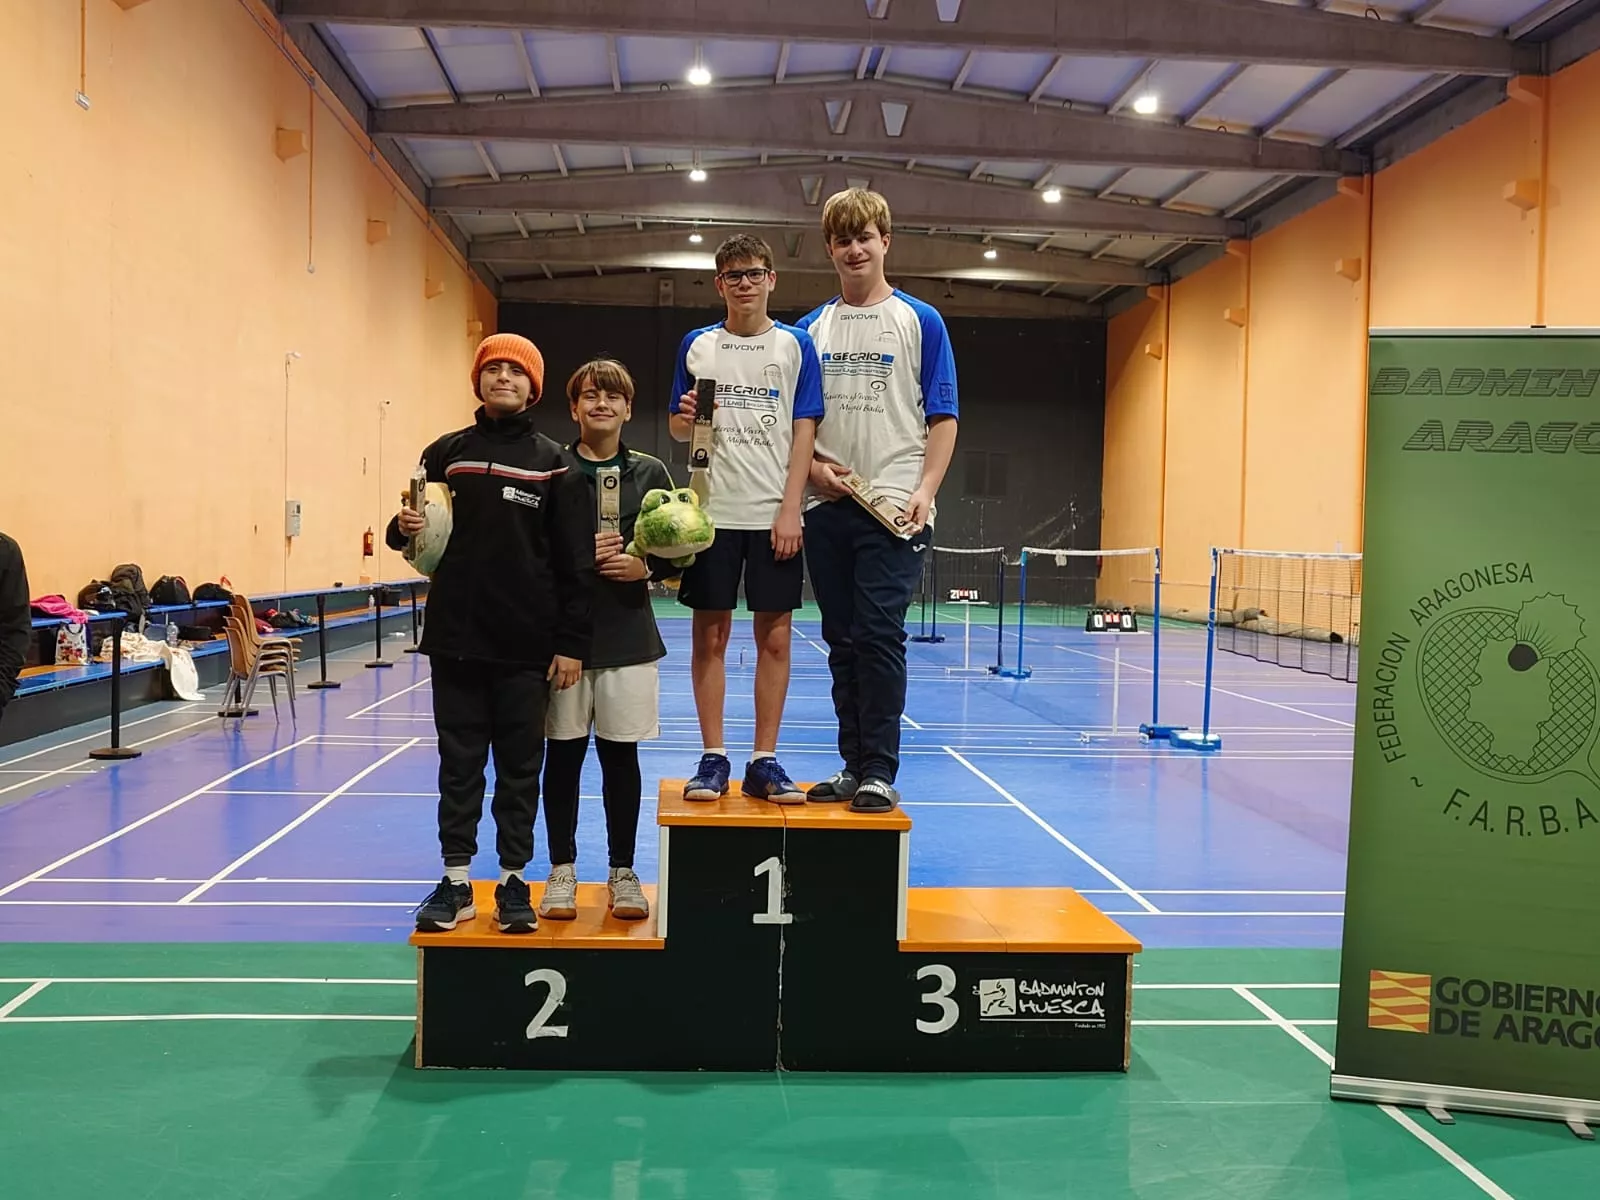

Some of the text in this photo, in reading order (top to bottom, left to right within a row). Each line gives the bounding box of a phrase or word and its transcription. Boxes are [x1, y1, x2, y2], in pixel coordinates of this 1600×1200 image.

[722, 343, 765, 351] GIVOVA
[832, 352, 881, 361] GECRIO
[950, 590, 960, 600] 21
[1094, 614, 1103, 628] 0
[1122, 614, 1132, 628] 0
[1372, 562, 1534, 764] FEDERACION ARAGONESA
[753, 857, 793, 925] 1
[1019, 980, 1104, 996] BADMINTON
[525, 969, 569, 1039] 2
[915, 965, 959, 1034] 3
[1019, 998, 1104, 1018] HUESCA
[1434, 1007, 1600, 1050] DE ARAG
